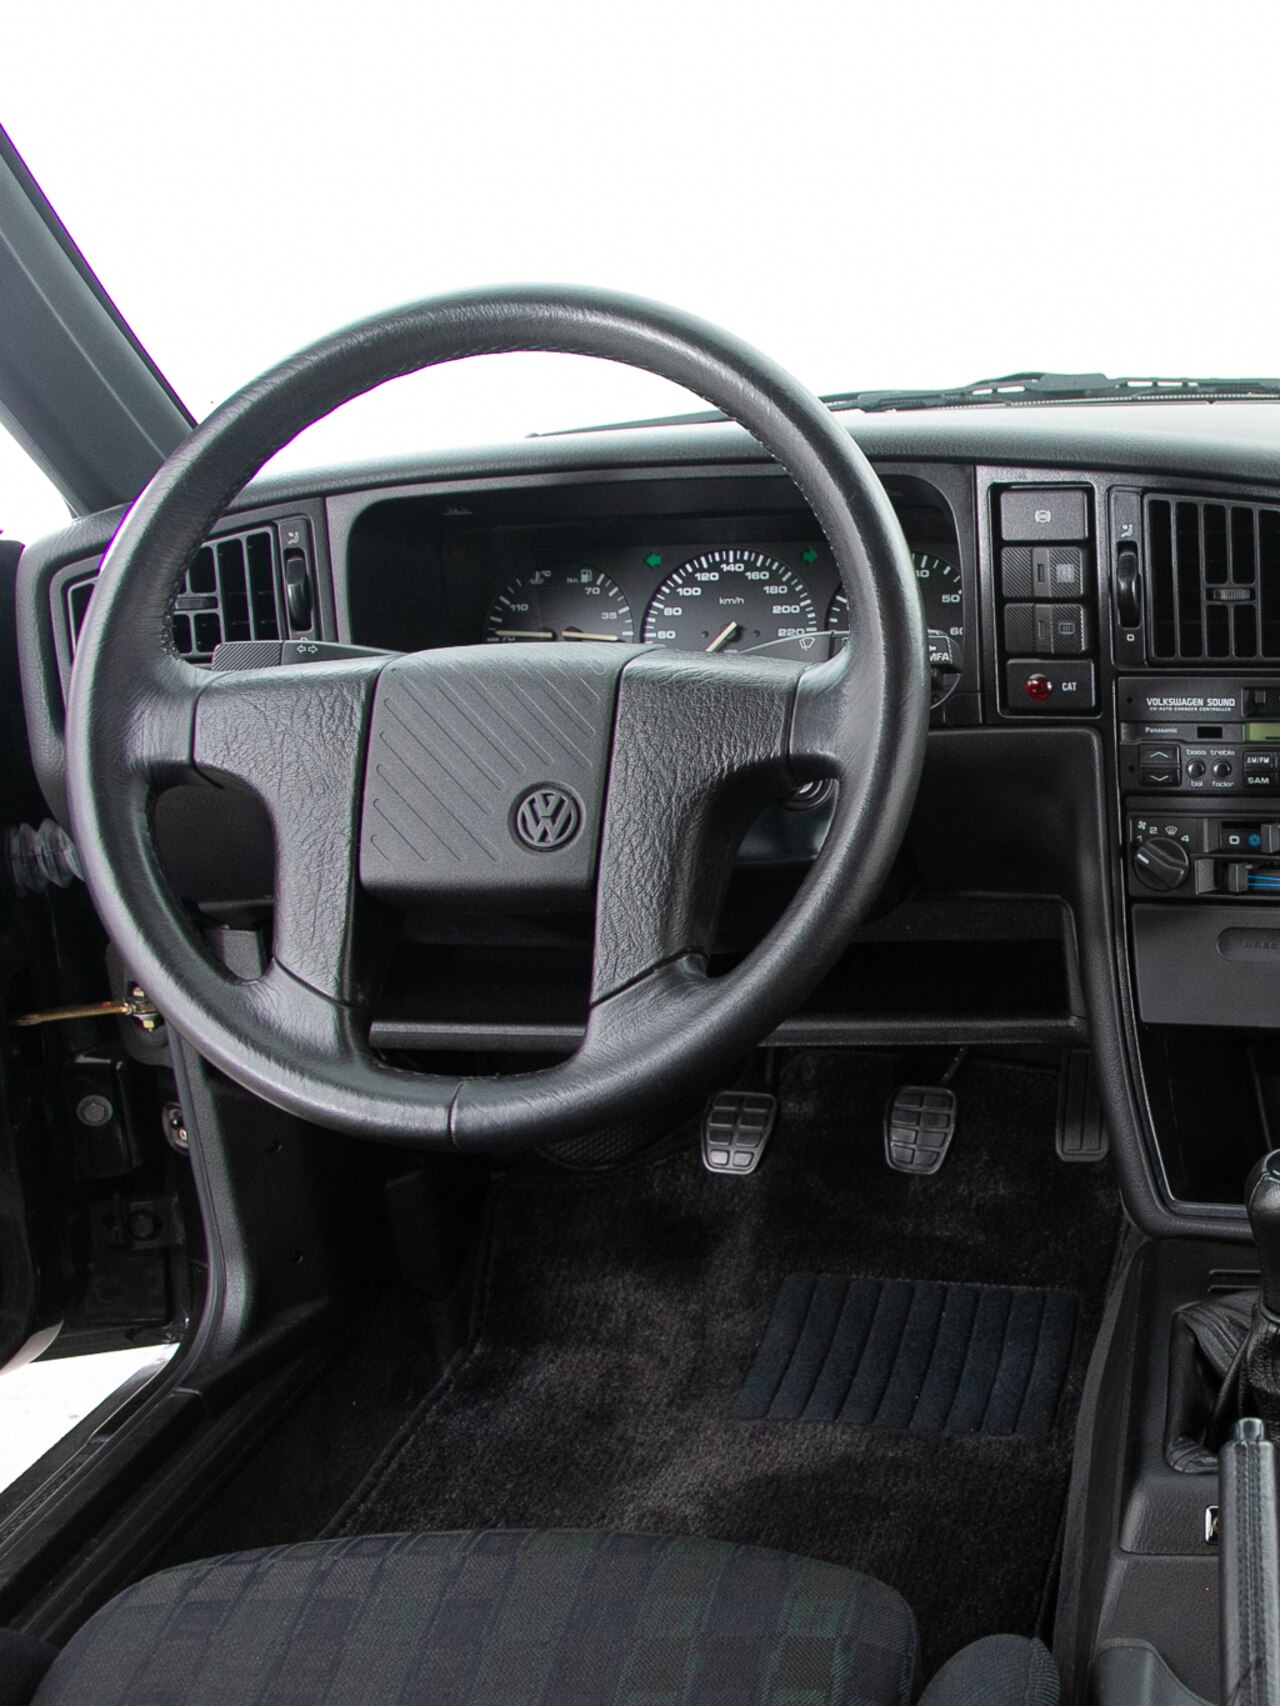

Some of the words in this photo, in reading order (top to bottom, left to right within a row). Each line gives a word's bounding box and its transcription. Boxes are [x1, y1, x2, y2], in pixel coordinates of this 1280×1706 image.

[720, 563, 744, 572] 140
[694, 572, 720, 581] 120
[745, 571, 769, 580] 160
[585, 587, 600, 595] 70
[676, 587, 702, 596] 100
[763, 585, 788, 595] 180
[719, 597, 744, 605] km/h
[941, 594, 960, 603] 50
[510, 604, 529, 612] 110
[663, 607, 682, 616] 80
[772, 605, 800, 614] 200
[601, 612, 617, 620] 35
[657, 631, 676, 639] 60
[777, 628, 805, 637] 220
[929, 652, 950, 662] MFA
[1062, 682, 1077, 691] CAT
[1146, 697, 1204, 707] VOLKSWAGEN
[1207, 698, 1236, 707] SOUND
[1186, 748, 1207, 756] bass
[1149, 826, 1158, 834] 2
[1181, 834, 1190, 842] 4
